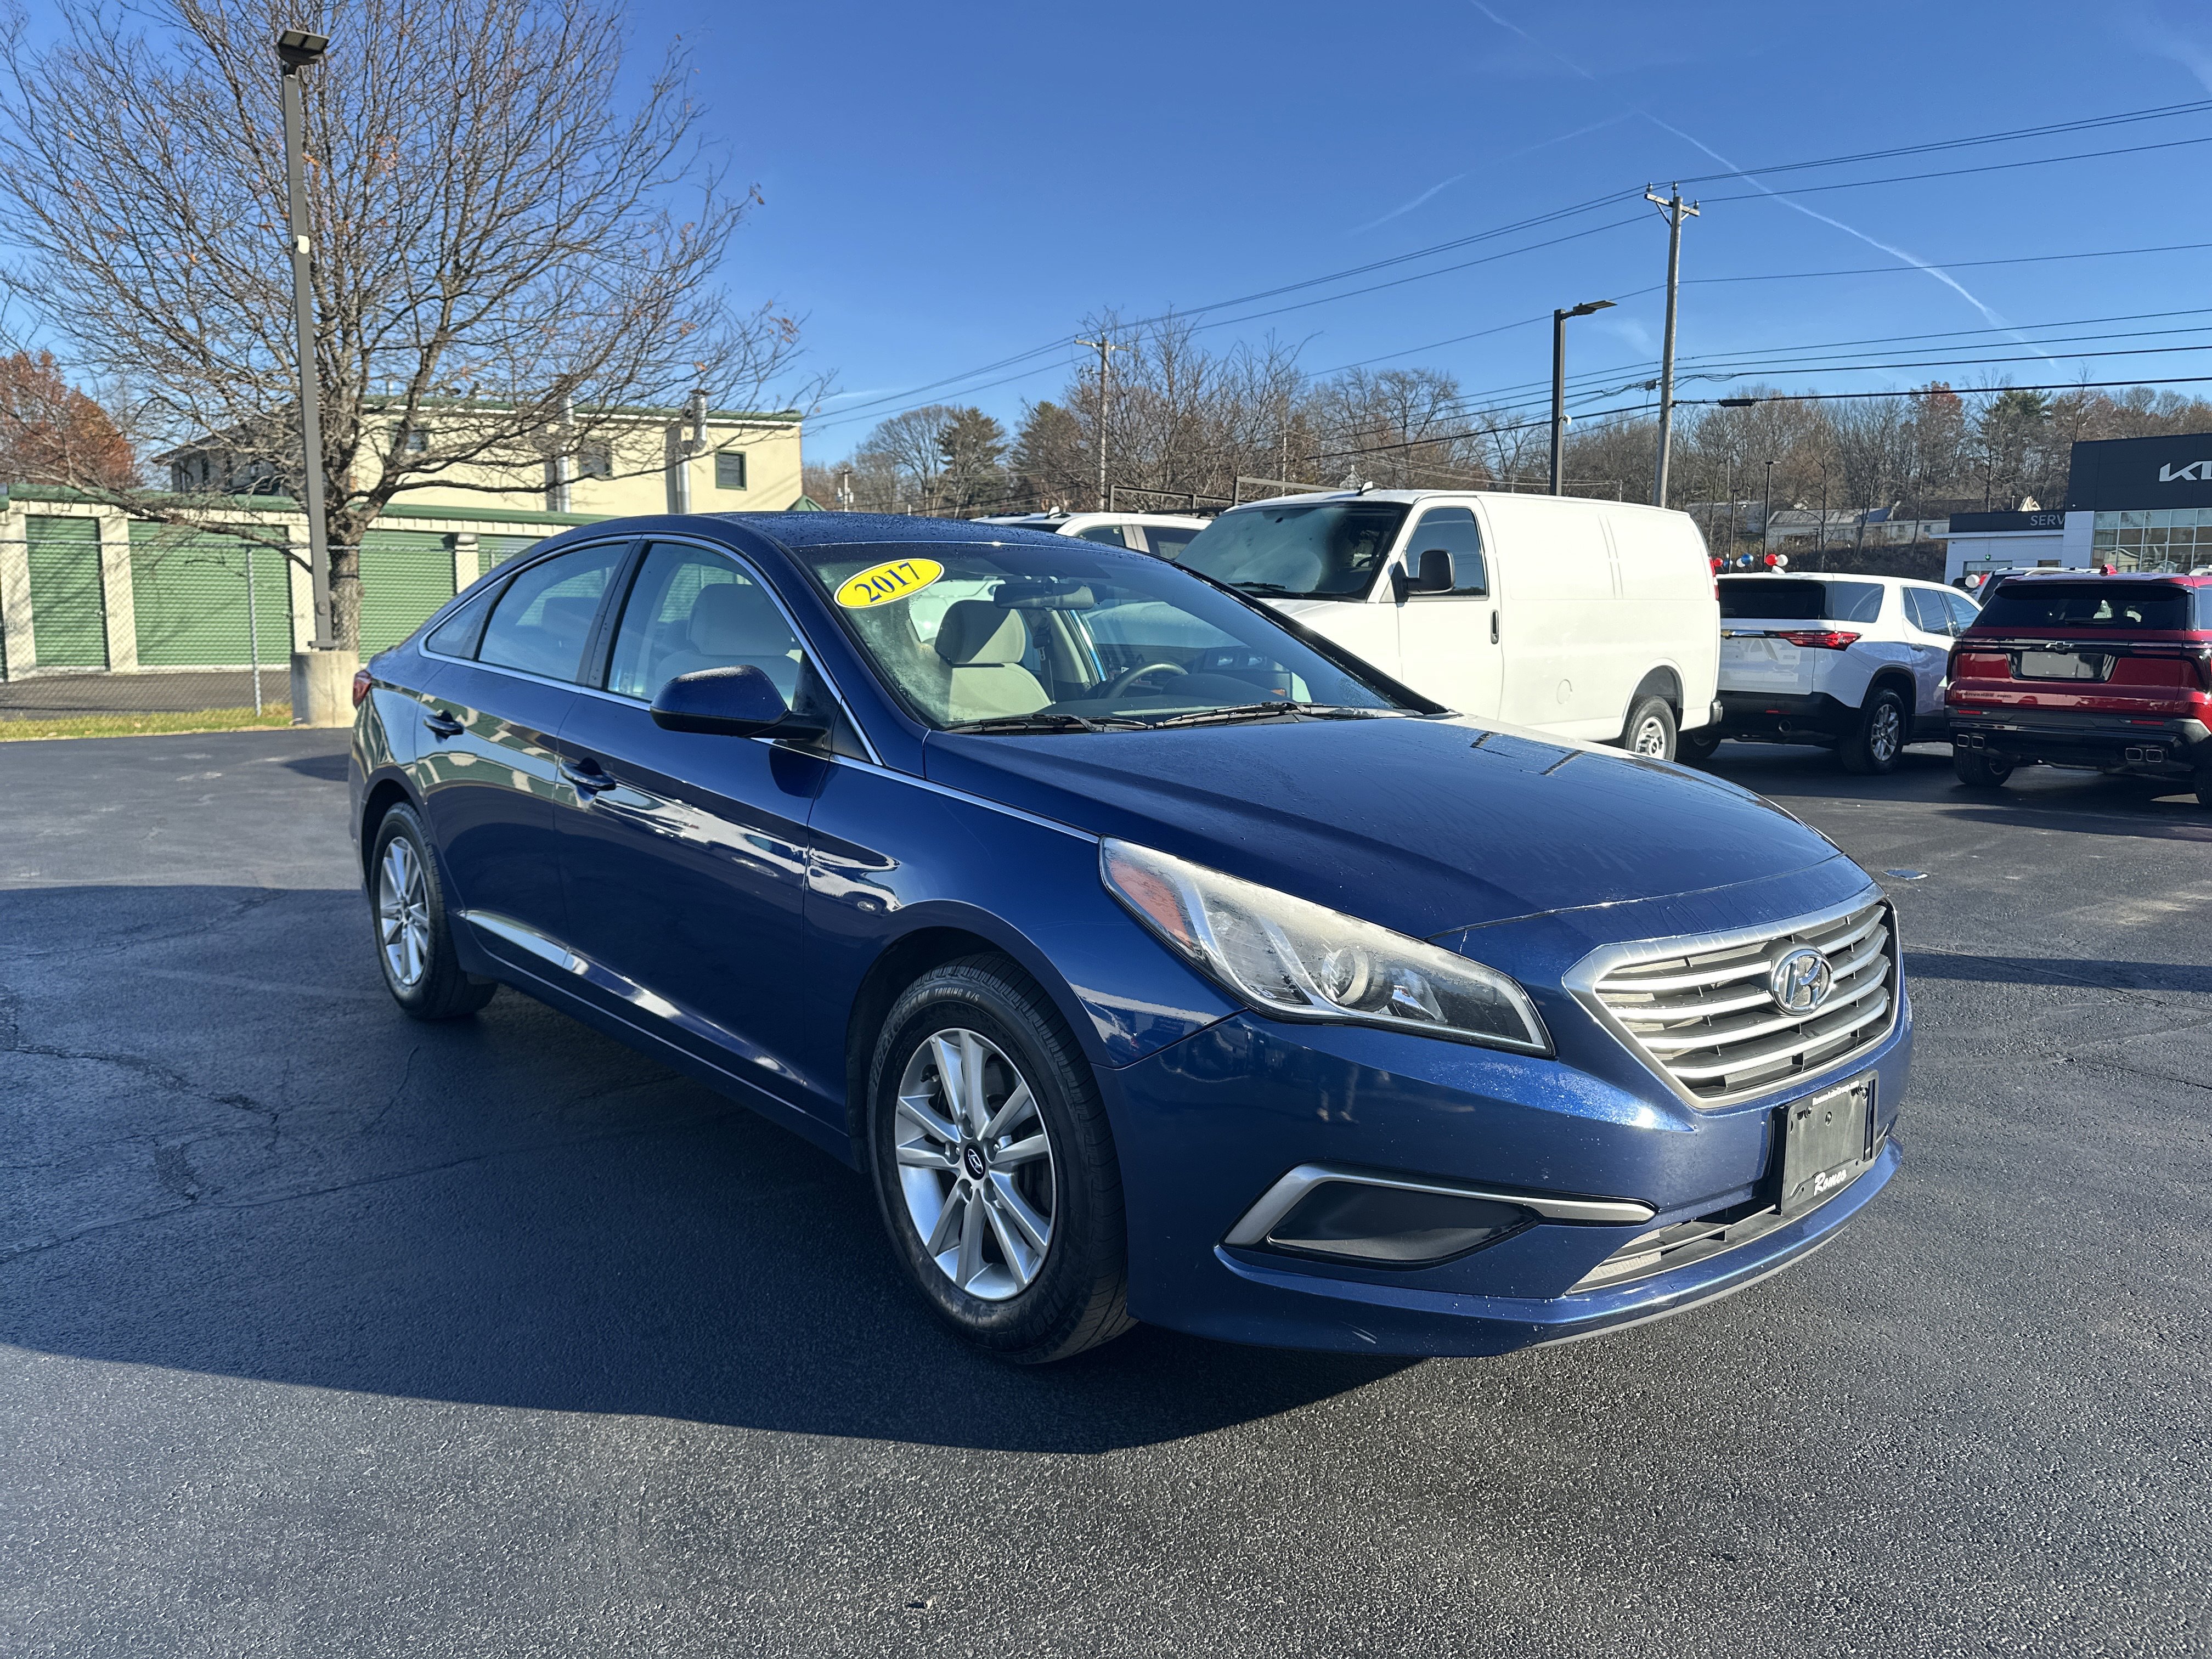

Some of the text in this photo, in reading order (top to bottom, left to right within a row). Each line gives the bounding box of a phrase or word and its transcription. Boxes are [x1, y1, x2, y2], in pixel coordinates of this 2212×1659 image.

[855, 562, 920, 602] 2017
[934, 987, 964, 997] TOURING
[965, 990, 980, 1003] A/S
